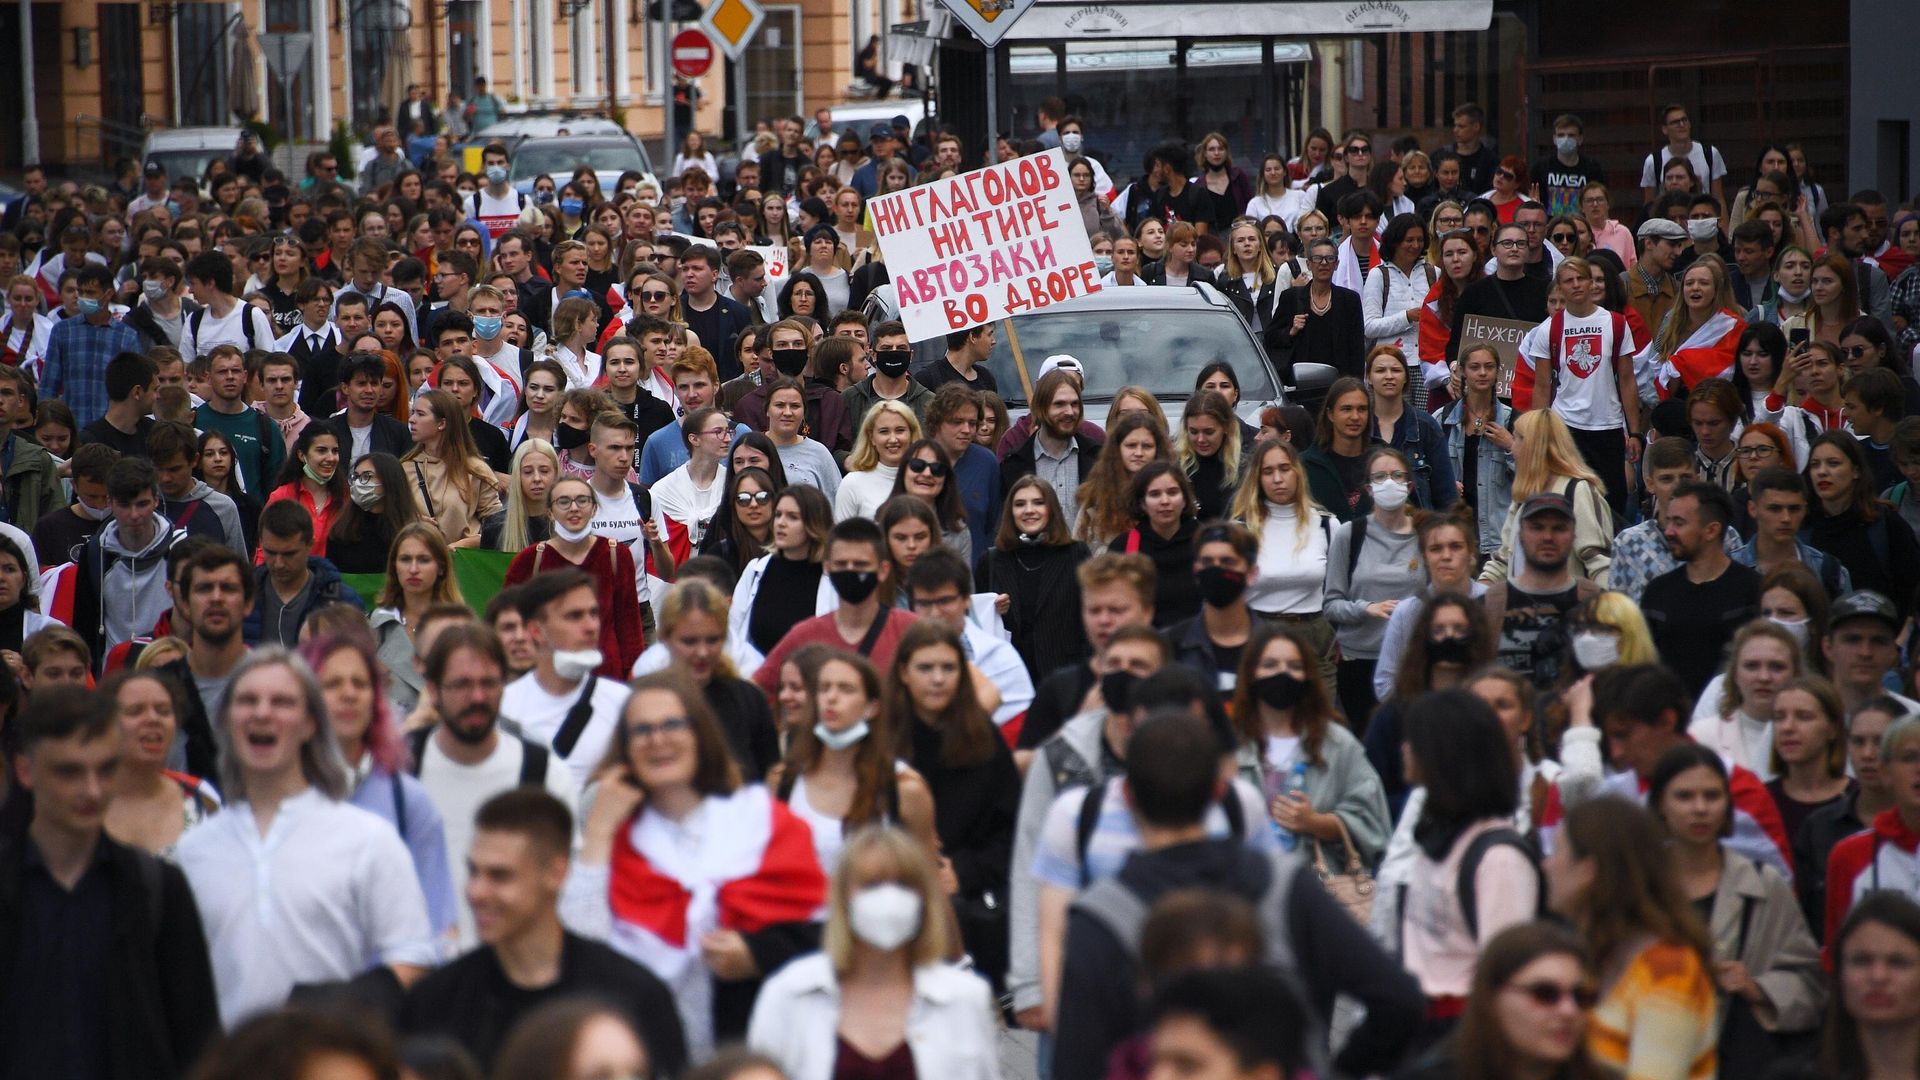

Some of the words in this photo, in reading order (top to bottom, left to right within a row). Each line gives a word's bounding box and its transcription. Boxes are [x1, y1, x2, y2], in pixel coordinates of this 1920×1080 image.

[1345, 0, 1411, 23] BERNARDIN
[871, 195, 911, 237] НИ
[909, 154, 1060, 227] ГЛАГОЛОВ
[1547, 172, 1587, 187] NASA
[928, 218, 974, 260] НИ
[896, 235, 1058, 309] АВТОЗАКИ
[943, 293, 989, 330] ВО
[1003, 260, 1103, 315] ДВОРЕ
[1466, 317, 1528, 344] НЕУЖЕЛ
[1564, 326, 1603, 336] BELARUS
